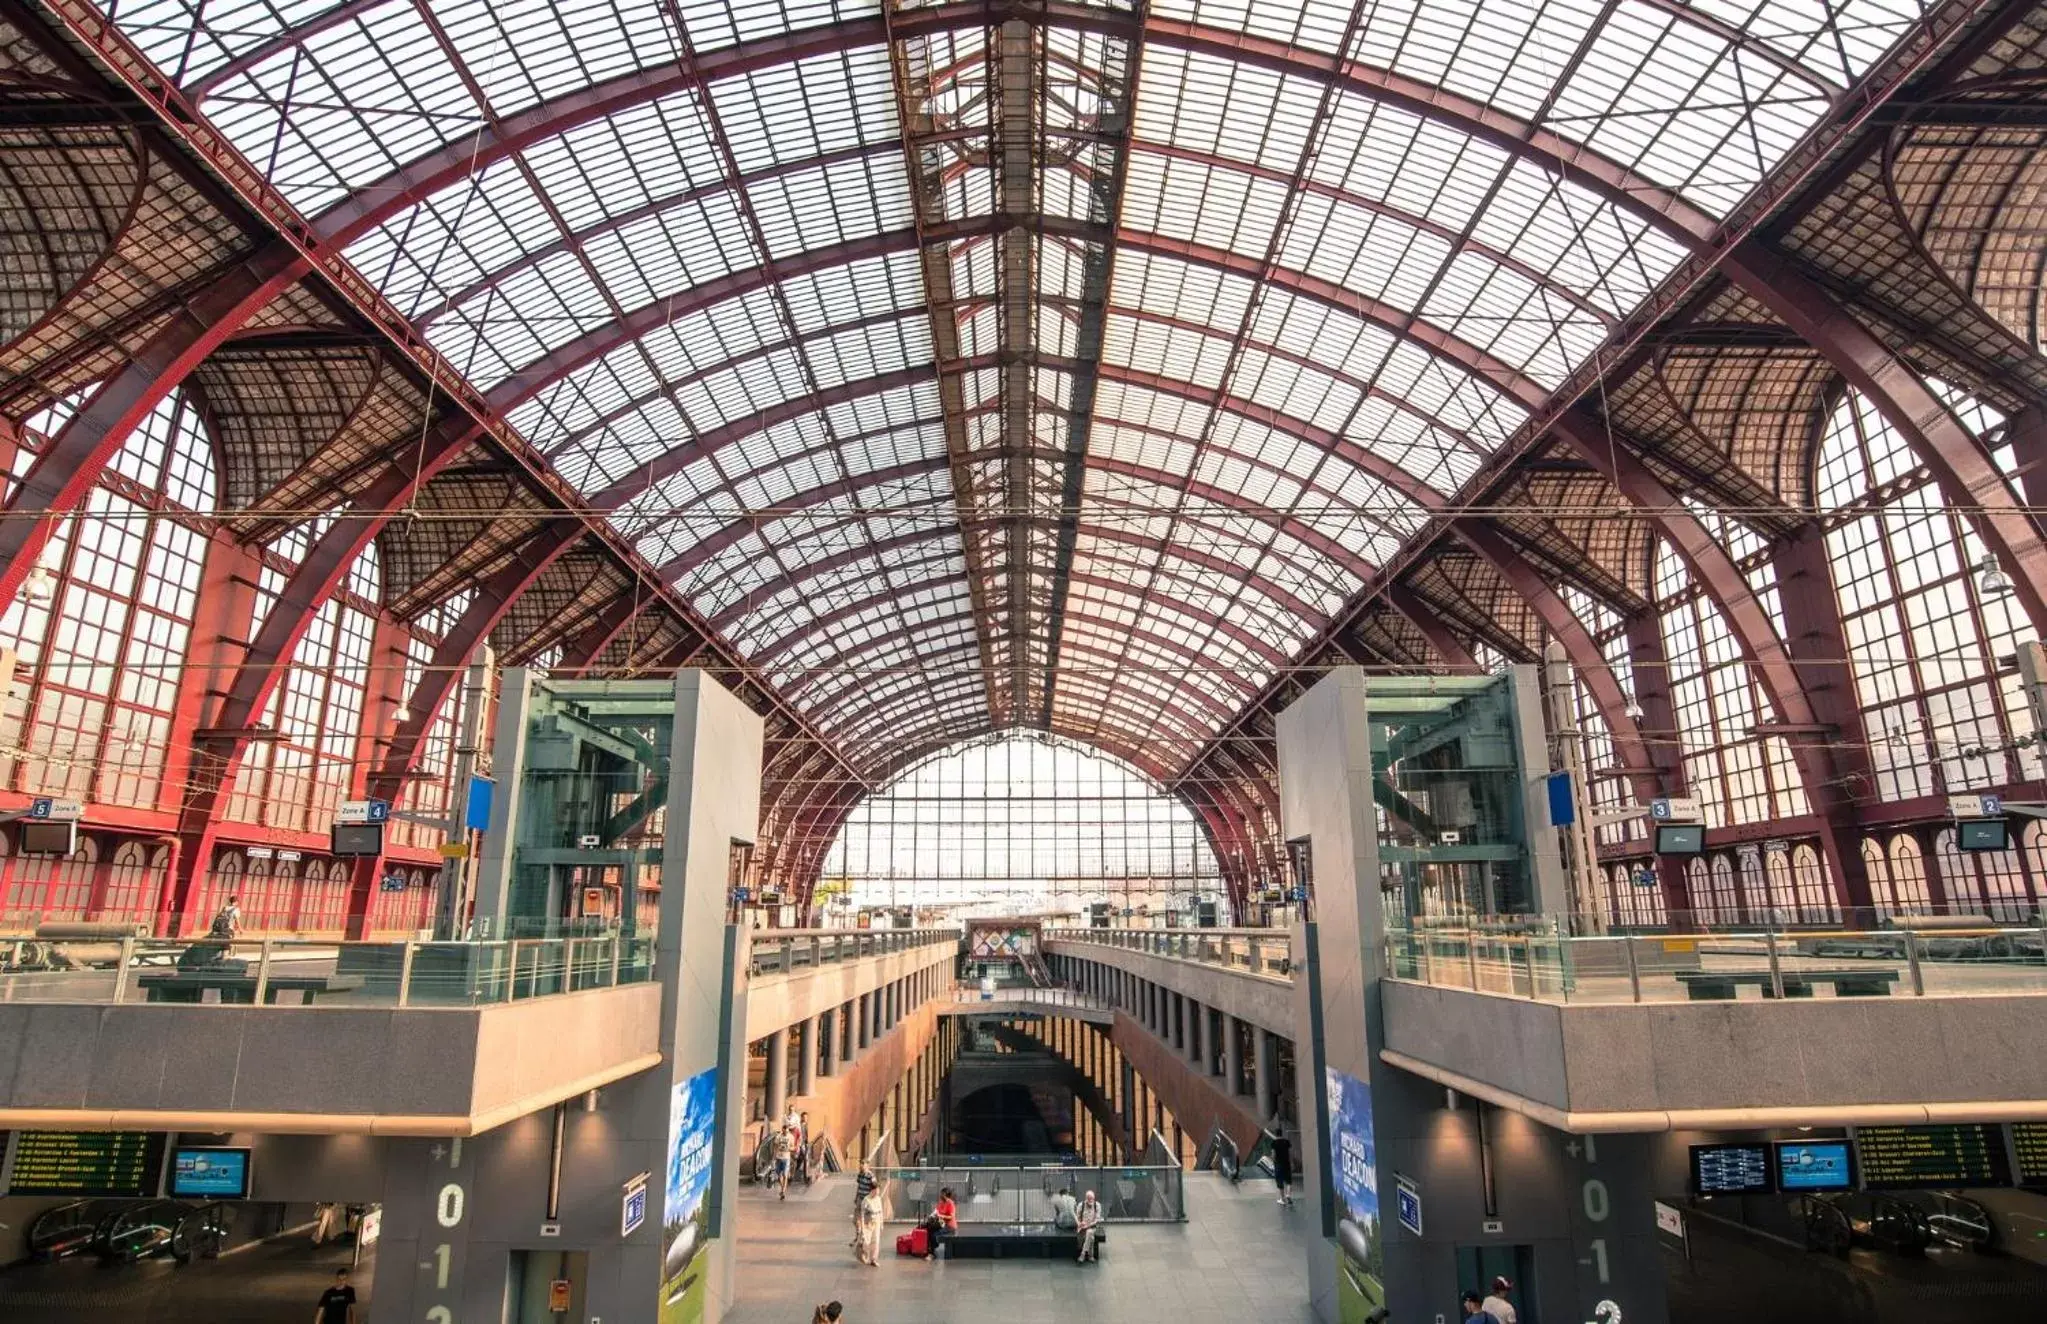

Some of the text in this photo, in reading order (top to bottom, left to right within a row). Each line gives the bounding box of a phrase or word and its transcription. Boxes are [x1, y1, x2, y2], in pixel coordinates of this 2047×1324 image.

[37, 804, 45, 815] 5
[373, 806, 380, 817] 4
[1657, 804, 1665, 816] 3
[1986, 801, 1995, 811] 2
[1342, 1149, 1377, 1195] DEACON
[437, 1183, 465, 1227] 0
[1582, 1179, 1609, 1222] 0
